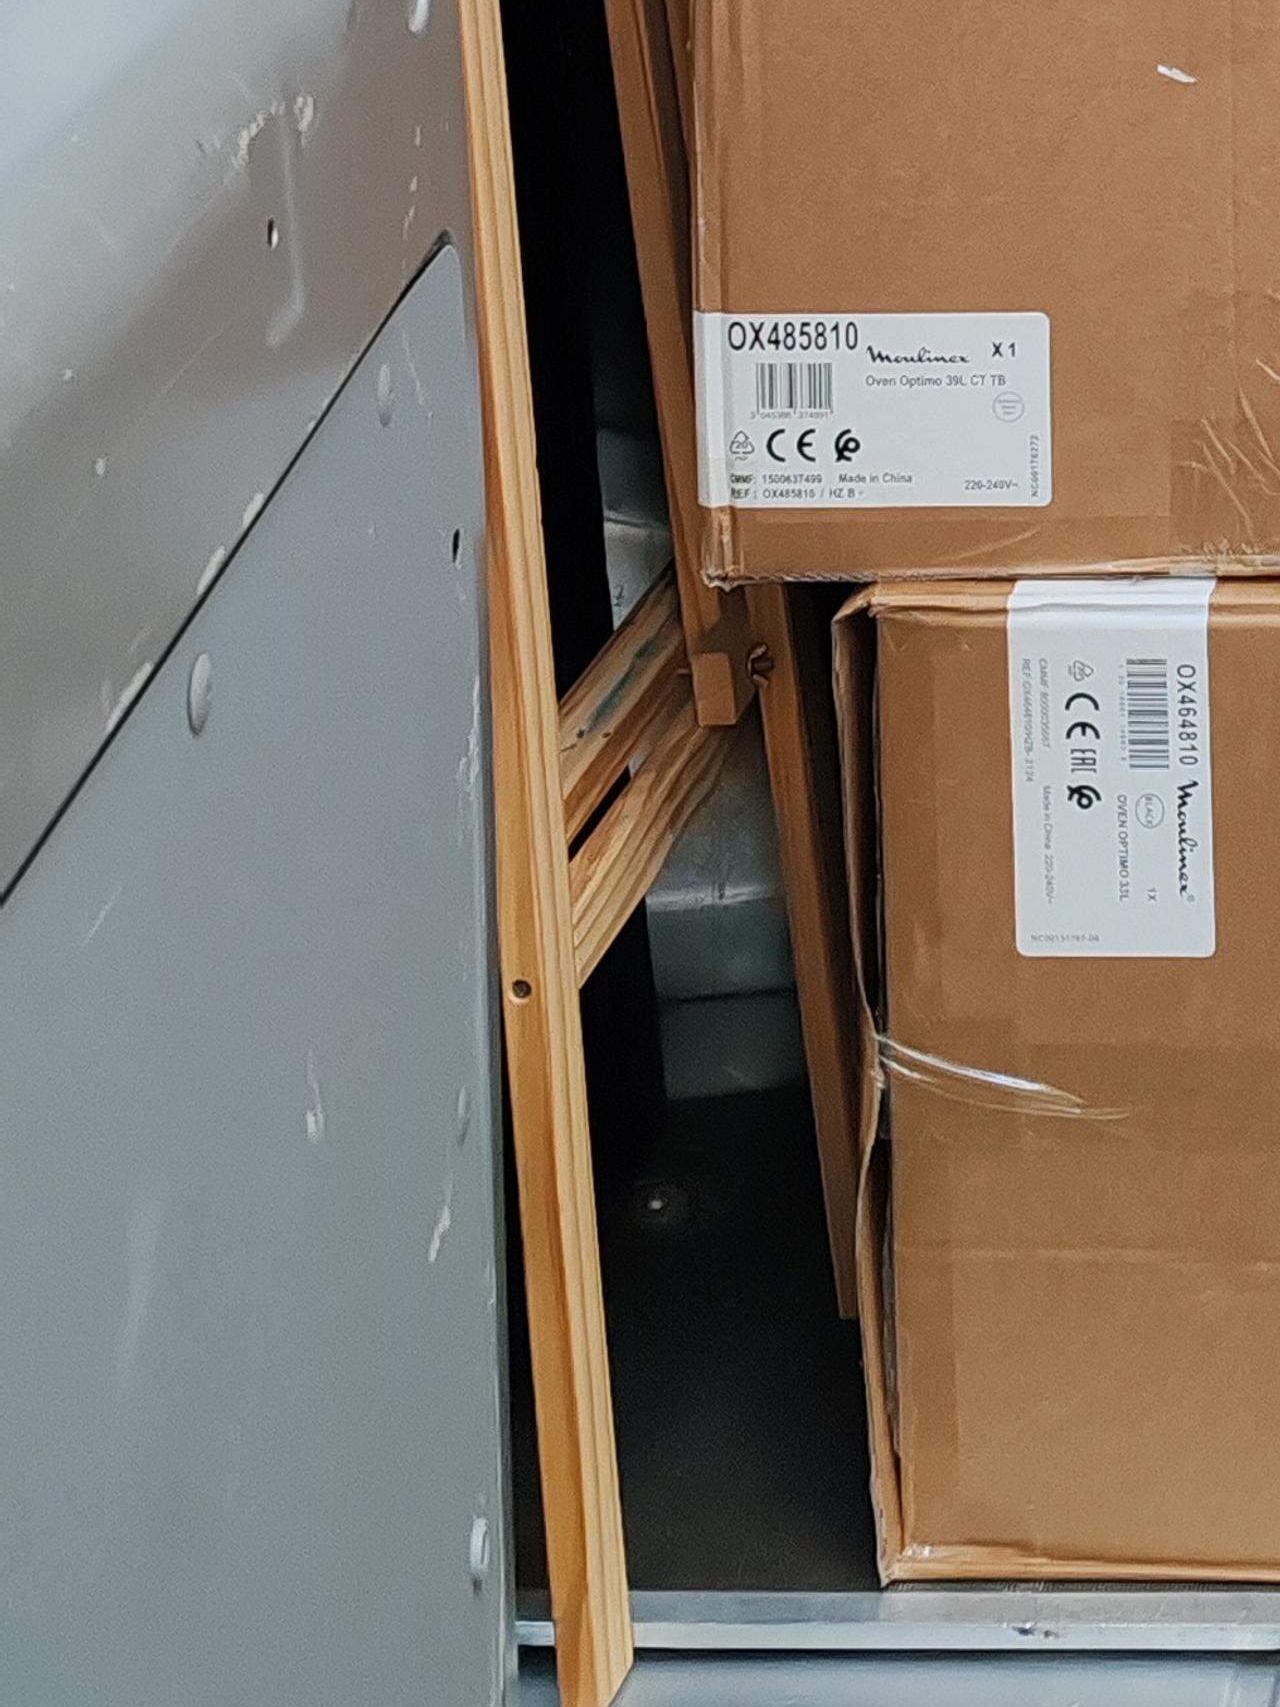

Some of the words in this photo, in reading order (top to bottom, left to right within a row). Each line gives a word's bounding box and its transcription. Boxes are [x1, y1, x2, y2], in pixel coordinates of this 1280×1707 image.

[728, 321, 860, 352] OX485810
[866, 345, 970, 364] Moulinex
[992, 342, 1003, 358] X
[1008, 342, 1017, 358] 1
[865, 374, 896, 387] Oven
[900, 374, 943, 389] Optimo
[838, 473, 867, 485] Made
[882, 472, 913, 485] China
[1176, 663, 1199, 767] OX464810
[1117, 795, 1129, 830] OVEN
[1175, 779, 1199, 896] Moulinex
[1117, 831, 1130, 879] OPTIMO
